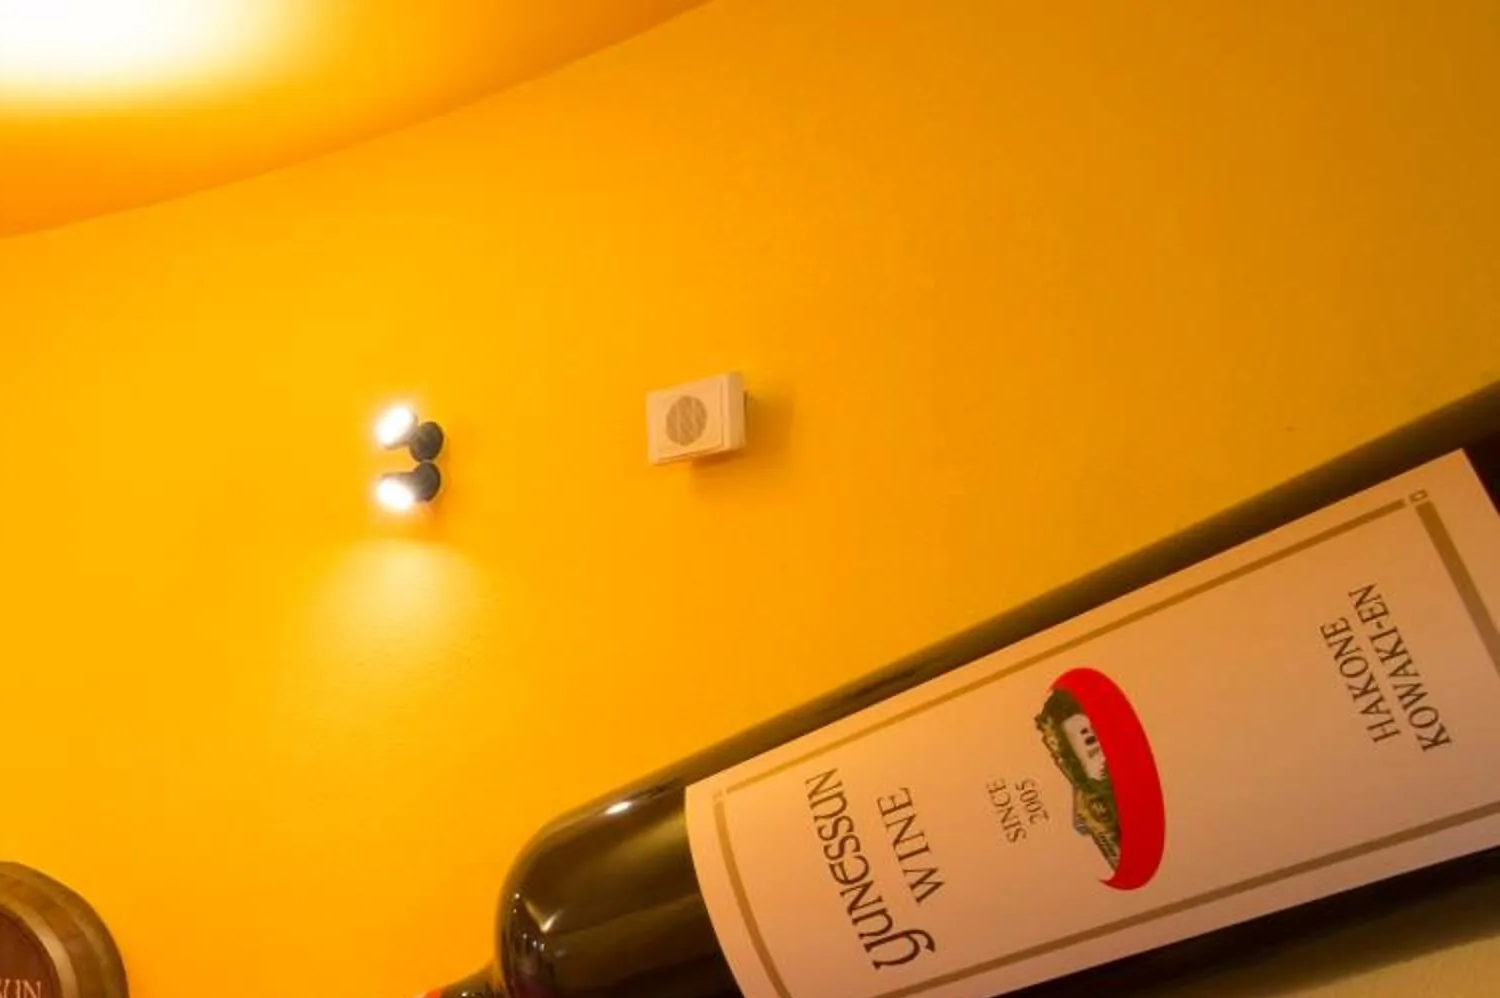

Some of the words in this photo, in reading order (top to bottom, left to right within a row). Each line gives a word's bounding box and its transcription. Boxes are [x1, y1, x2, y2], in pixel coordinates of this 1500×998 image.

[1319, 616, 1402, 743] HAKONE
[1347, 582, 1453, 752] KOWAKI-EN
[876, 786, 946, 904] WINE
[986, 778, 1028, 844] SINCE
[1015, 779, 1050, 825] 2005
[804, 767, 937, 971] YUNESSUN
